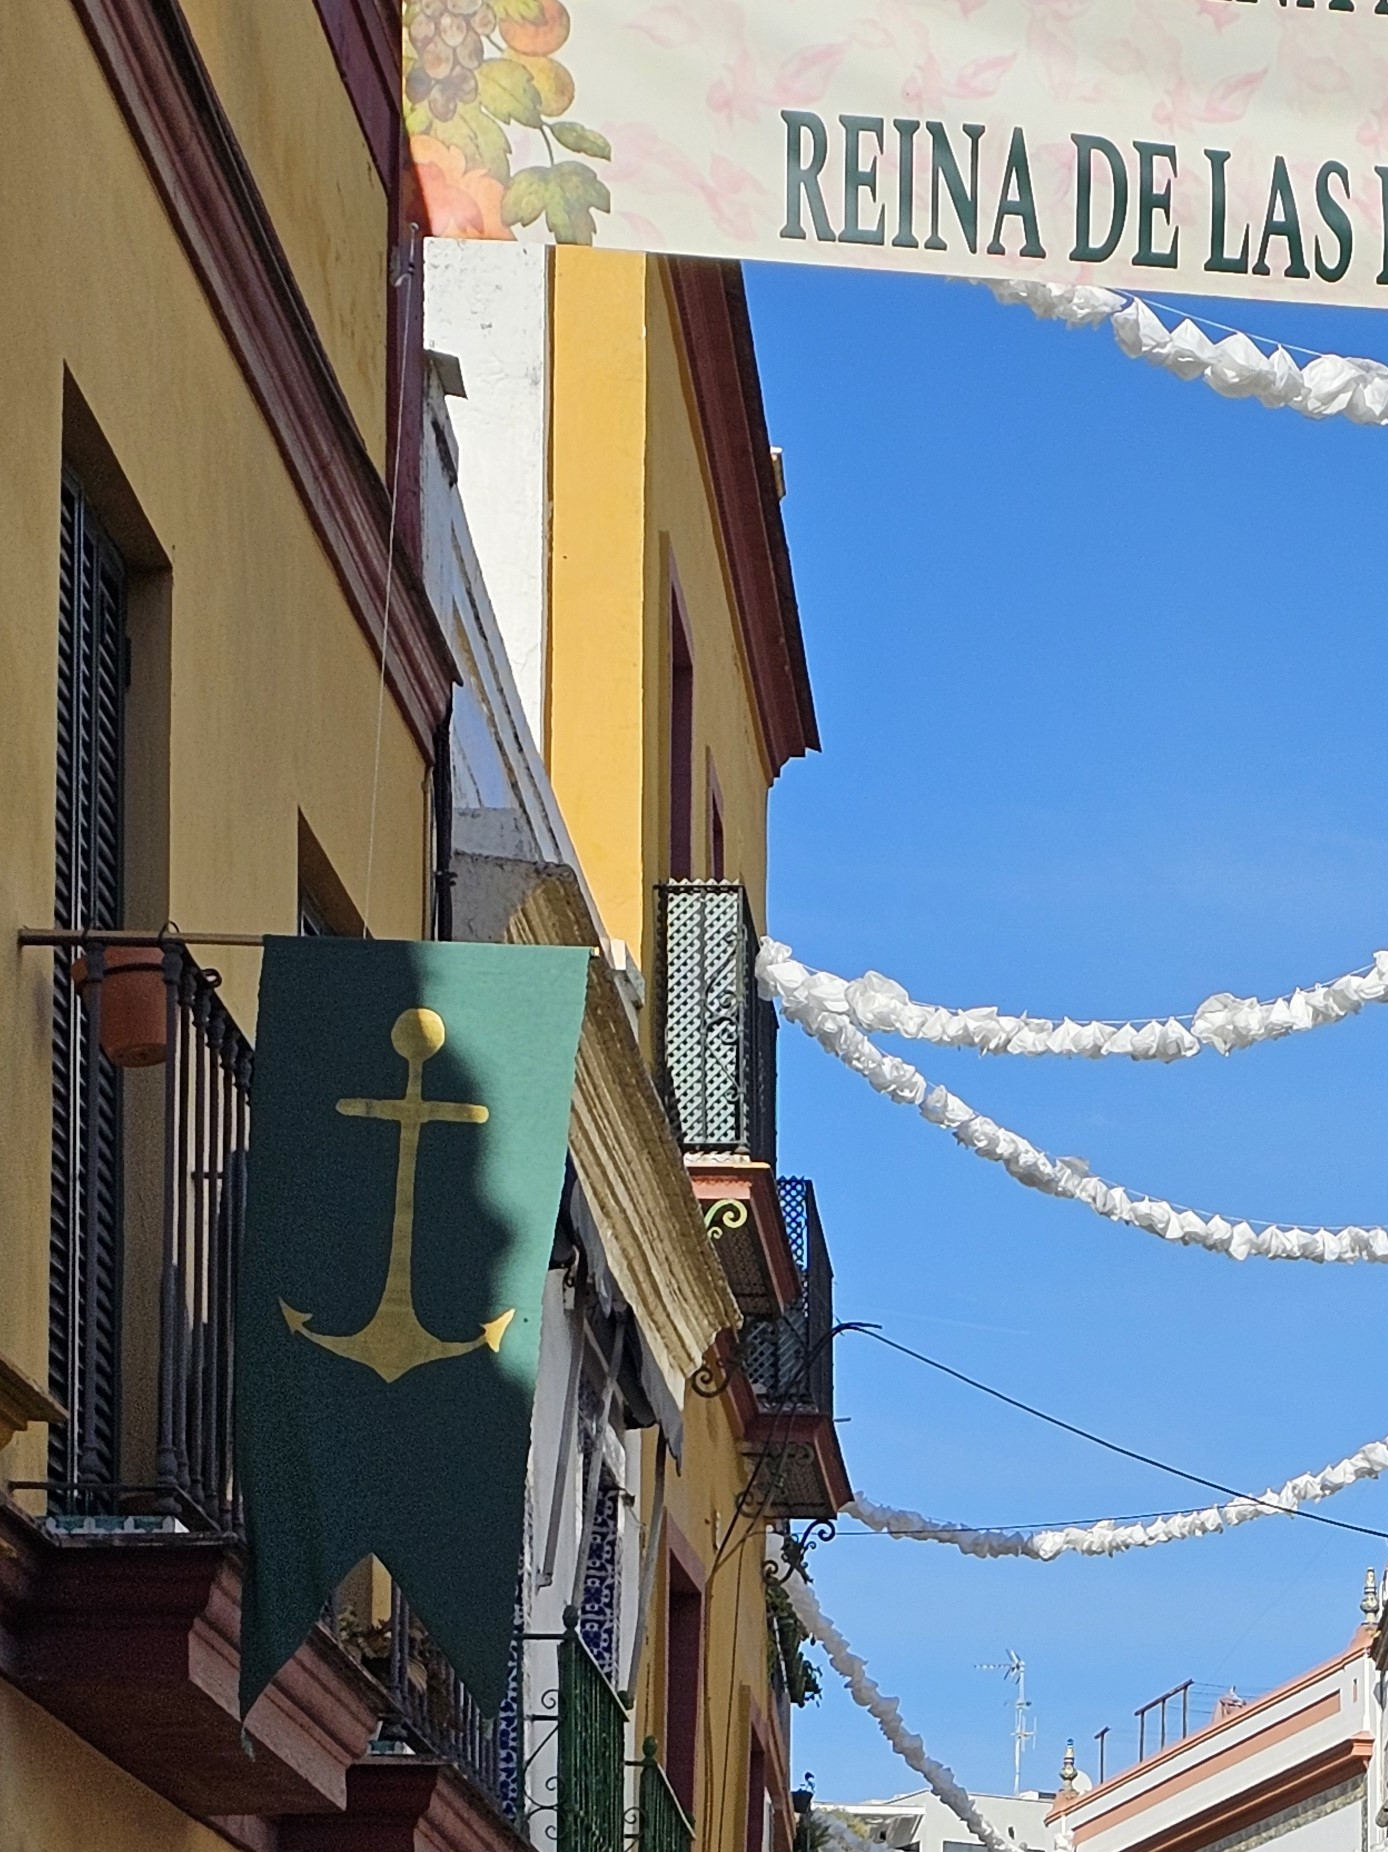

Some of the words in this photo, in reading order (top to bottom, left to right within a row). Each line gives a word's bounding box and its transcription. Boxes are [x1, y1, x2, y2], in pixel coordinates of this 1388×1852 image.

[778, 109, 1047, 260] REINA
[1068, 132, 1180, 268] DE
[1202, 148, 1353, 284] LAS
